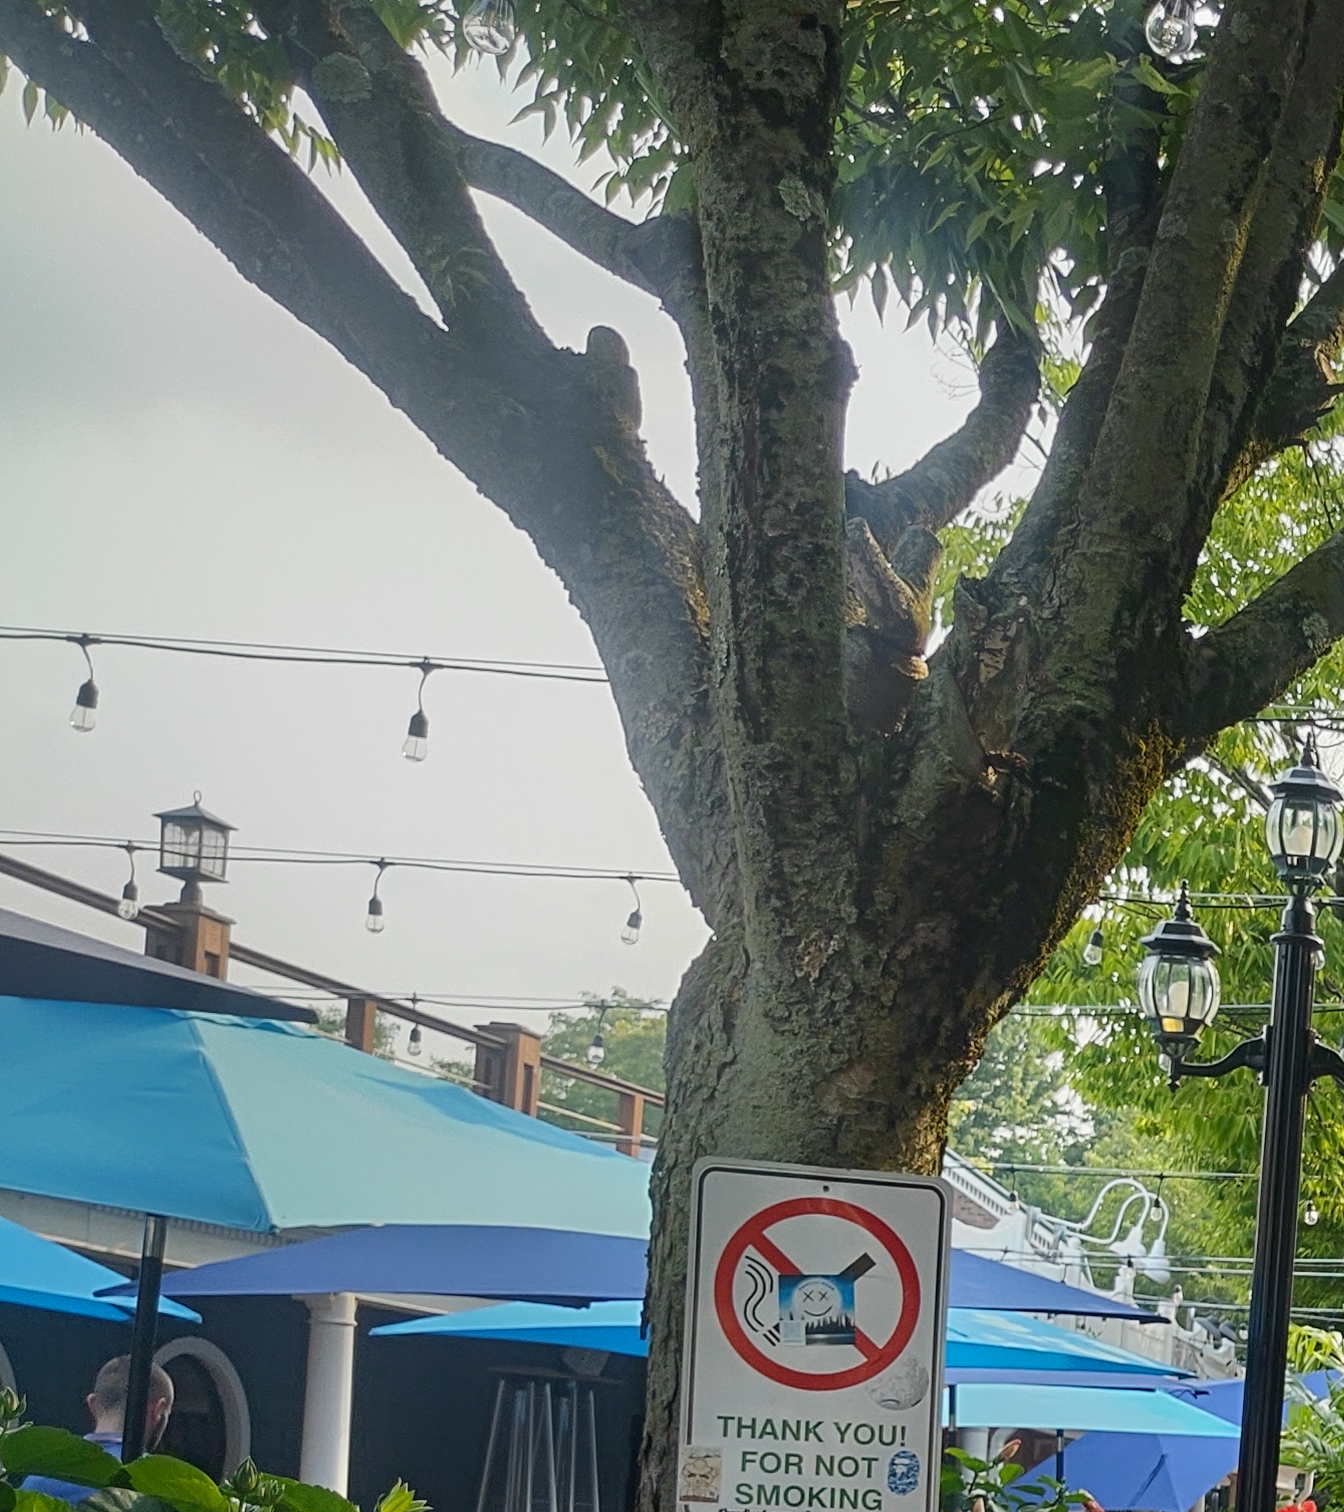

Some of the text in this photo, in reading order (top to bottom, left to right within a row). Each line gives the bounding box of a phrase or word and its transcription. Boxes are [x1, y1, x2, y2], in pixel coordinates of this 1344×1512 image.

[716, 1415, 907, 1447] THANK YOU!
[740, 1451, 879, 1479] FOR NOT
[735, 1483, 883, 1511] SMOKING
